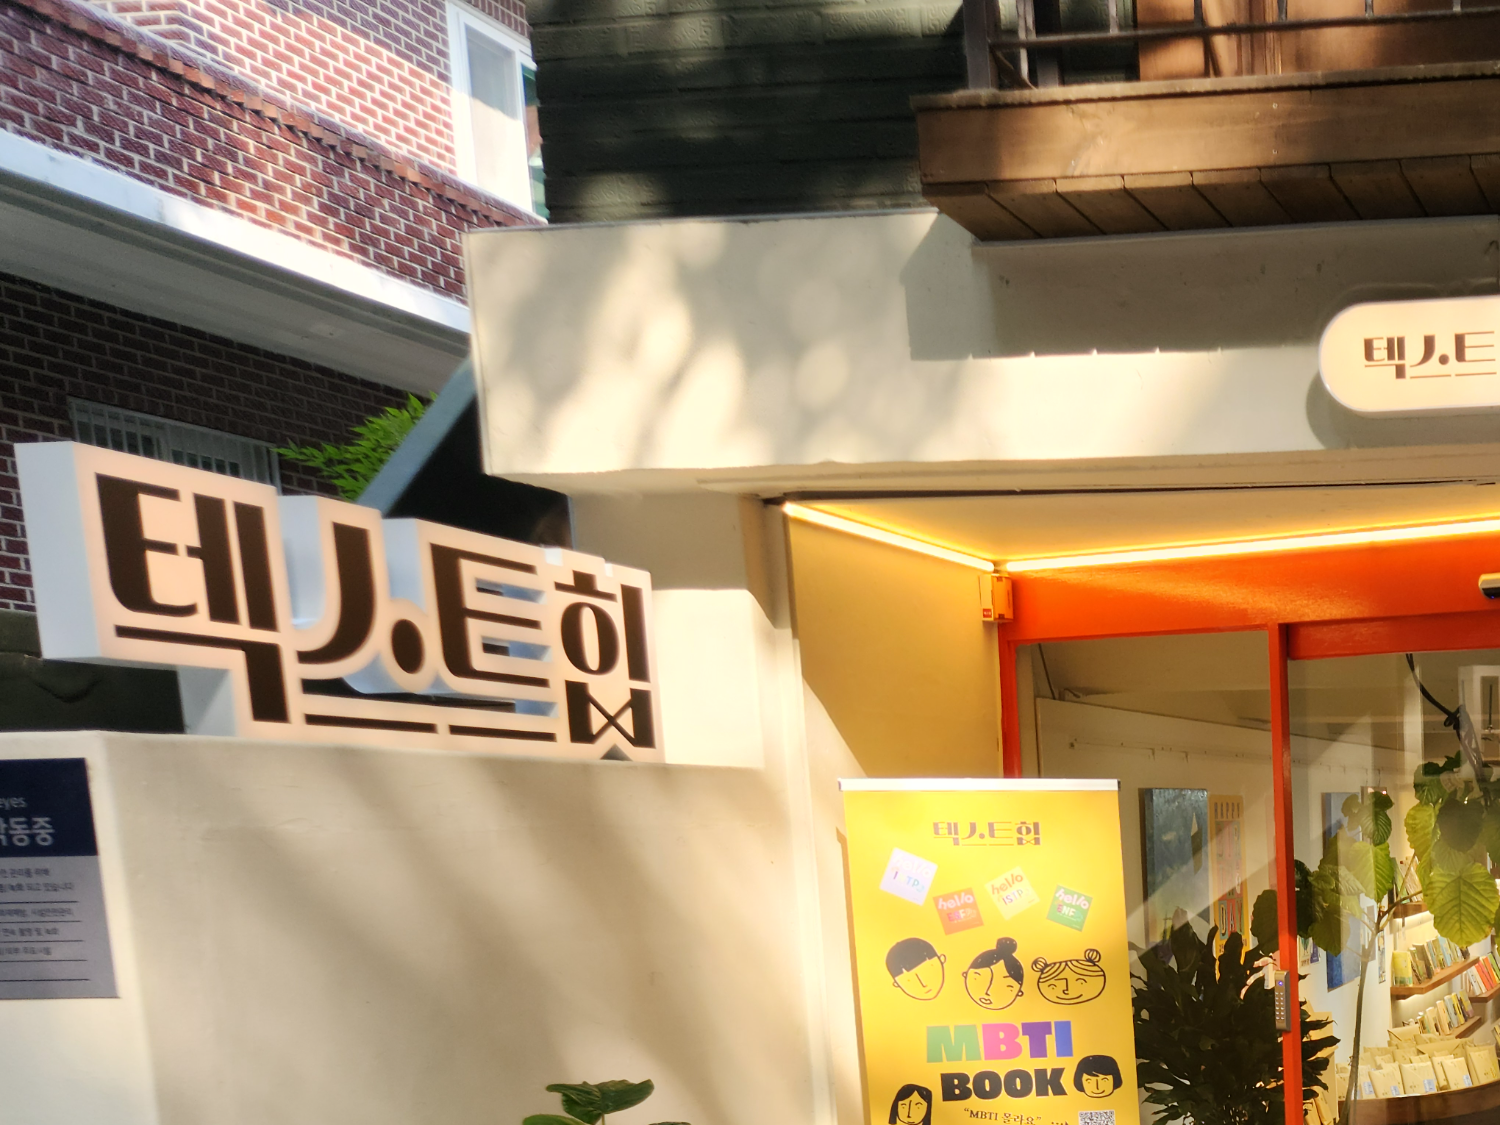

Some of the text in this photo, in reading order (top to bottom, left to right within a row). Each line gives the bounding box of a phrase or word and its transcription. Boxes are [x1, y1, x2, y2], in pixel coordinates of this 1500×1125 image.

[95, 472, 656, 749] 텍스트힙
[933, 821, 1041, 846] 텍스트힙
[893, 871, 920, 888] ITP
[991, 873, 1024, 895] hello
[938, 892, 974, 910] hello
[1055, 888, 1090, 910] hello
[926, 1020, 1074, 1063] MBTI
[940, 1067, 1068, 1102] BOOK
